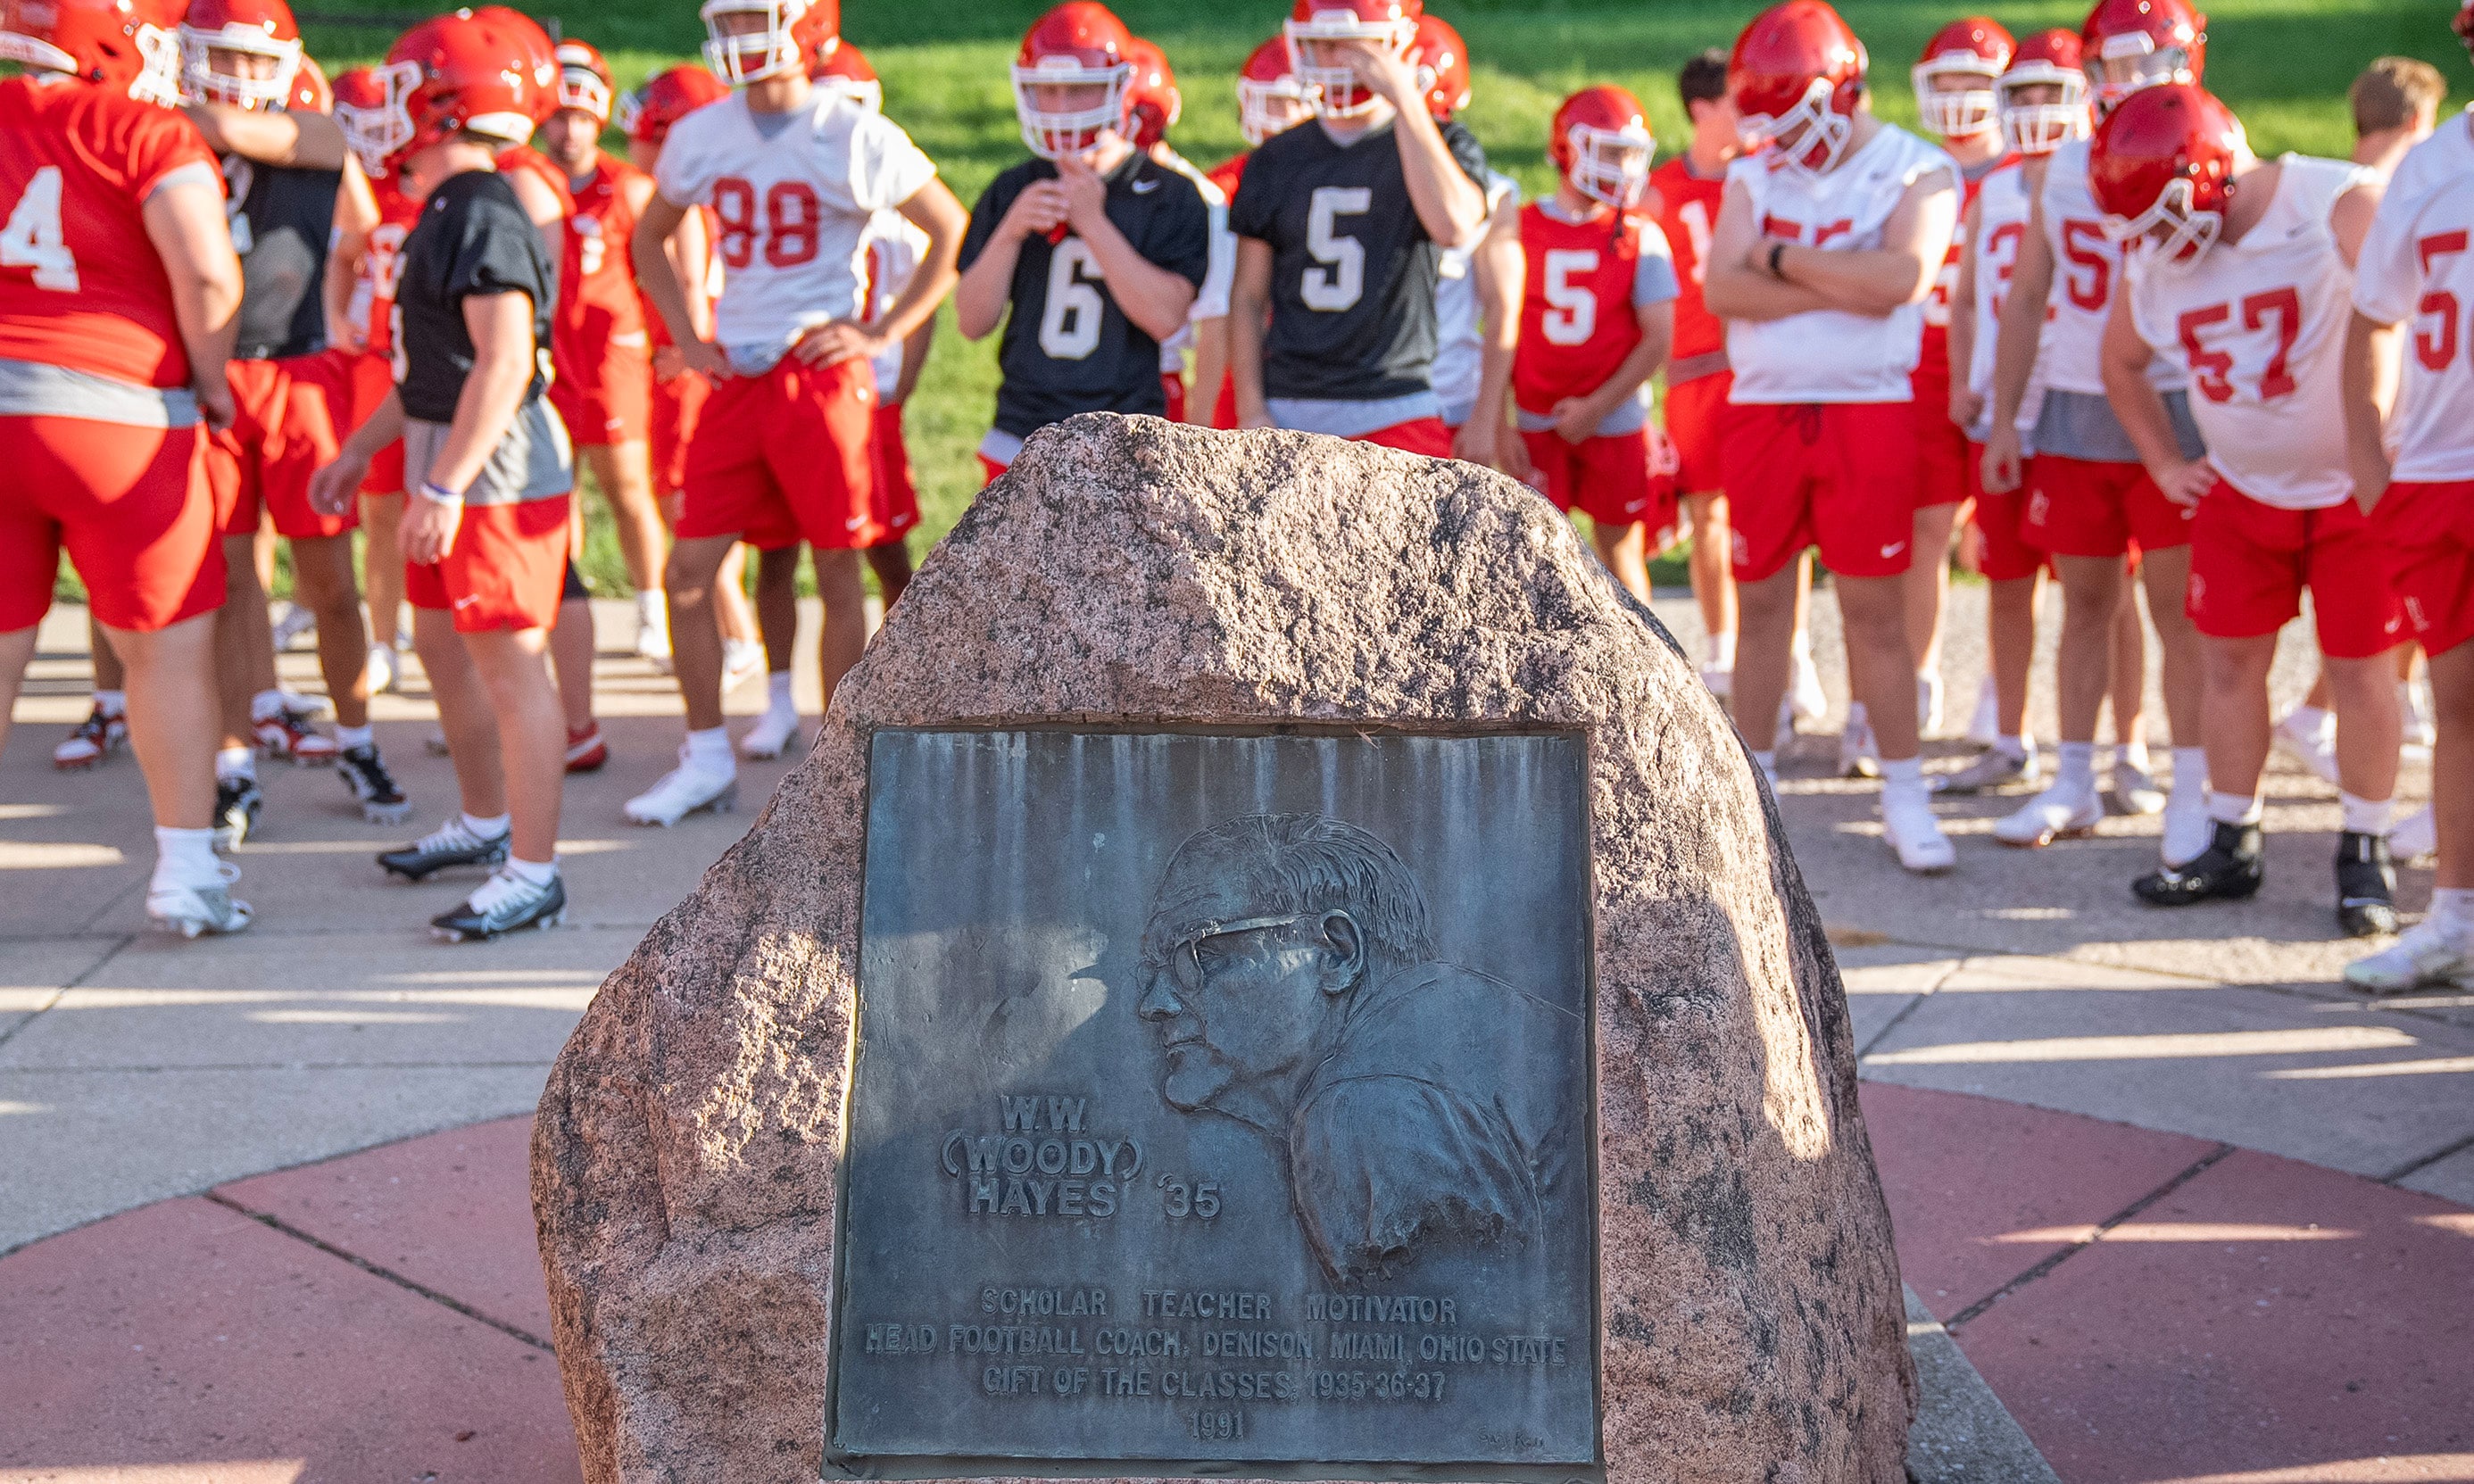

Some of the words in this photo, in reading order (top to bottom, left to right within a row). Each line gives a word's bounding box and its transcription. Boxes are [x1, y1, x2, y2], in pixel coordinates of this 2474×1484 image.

[0, 167, 80, 293] 4
[714, 178, 820, 268] 88
[1300, 187, 1373, 311] 5
[1039, 236, 1104, 360] 6
[1542, 249, 1600, 346] 5
[2179, 286, 2298, 402] 57
[940, 1128, 1144, 1181] (WOODY)
[968, 1177, 1117, 1217] HAYES
[982, 1288, 1107, 1317] SCHOLAR
[1143, 1290, 1272, 1321] TEACHER
[1306, 1294, 1457, 1326] MOTIVATOR
[866, 1325, 938, 1354] HEAD
[949, 1325, 1084, 1355] FOOTBALL
[1203, 1331, 1322, 1364] DENISON,
[1330, 1336, 1413, 1367] MIAMI,
[1420, 1336, 1485, 1364] OHIO
[1492, 1337, 1566, 1365] STATE
[983, 1367, 1045, 1395] GIFT
[1054, 1369, 1086, 1396] OF
[1100, 1368, 1152, 1397] THE
[1189, 1412, 1245, 1439] 1991
